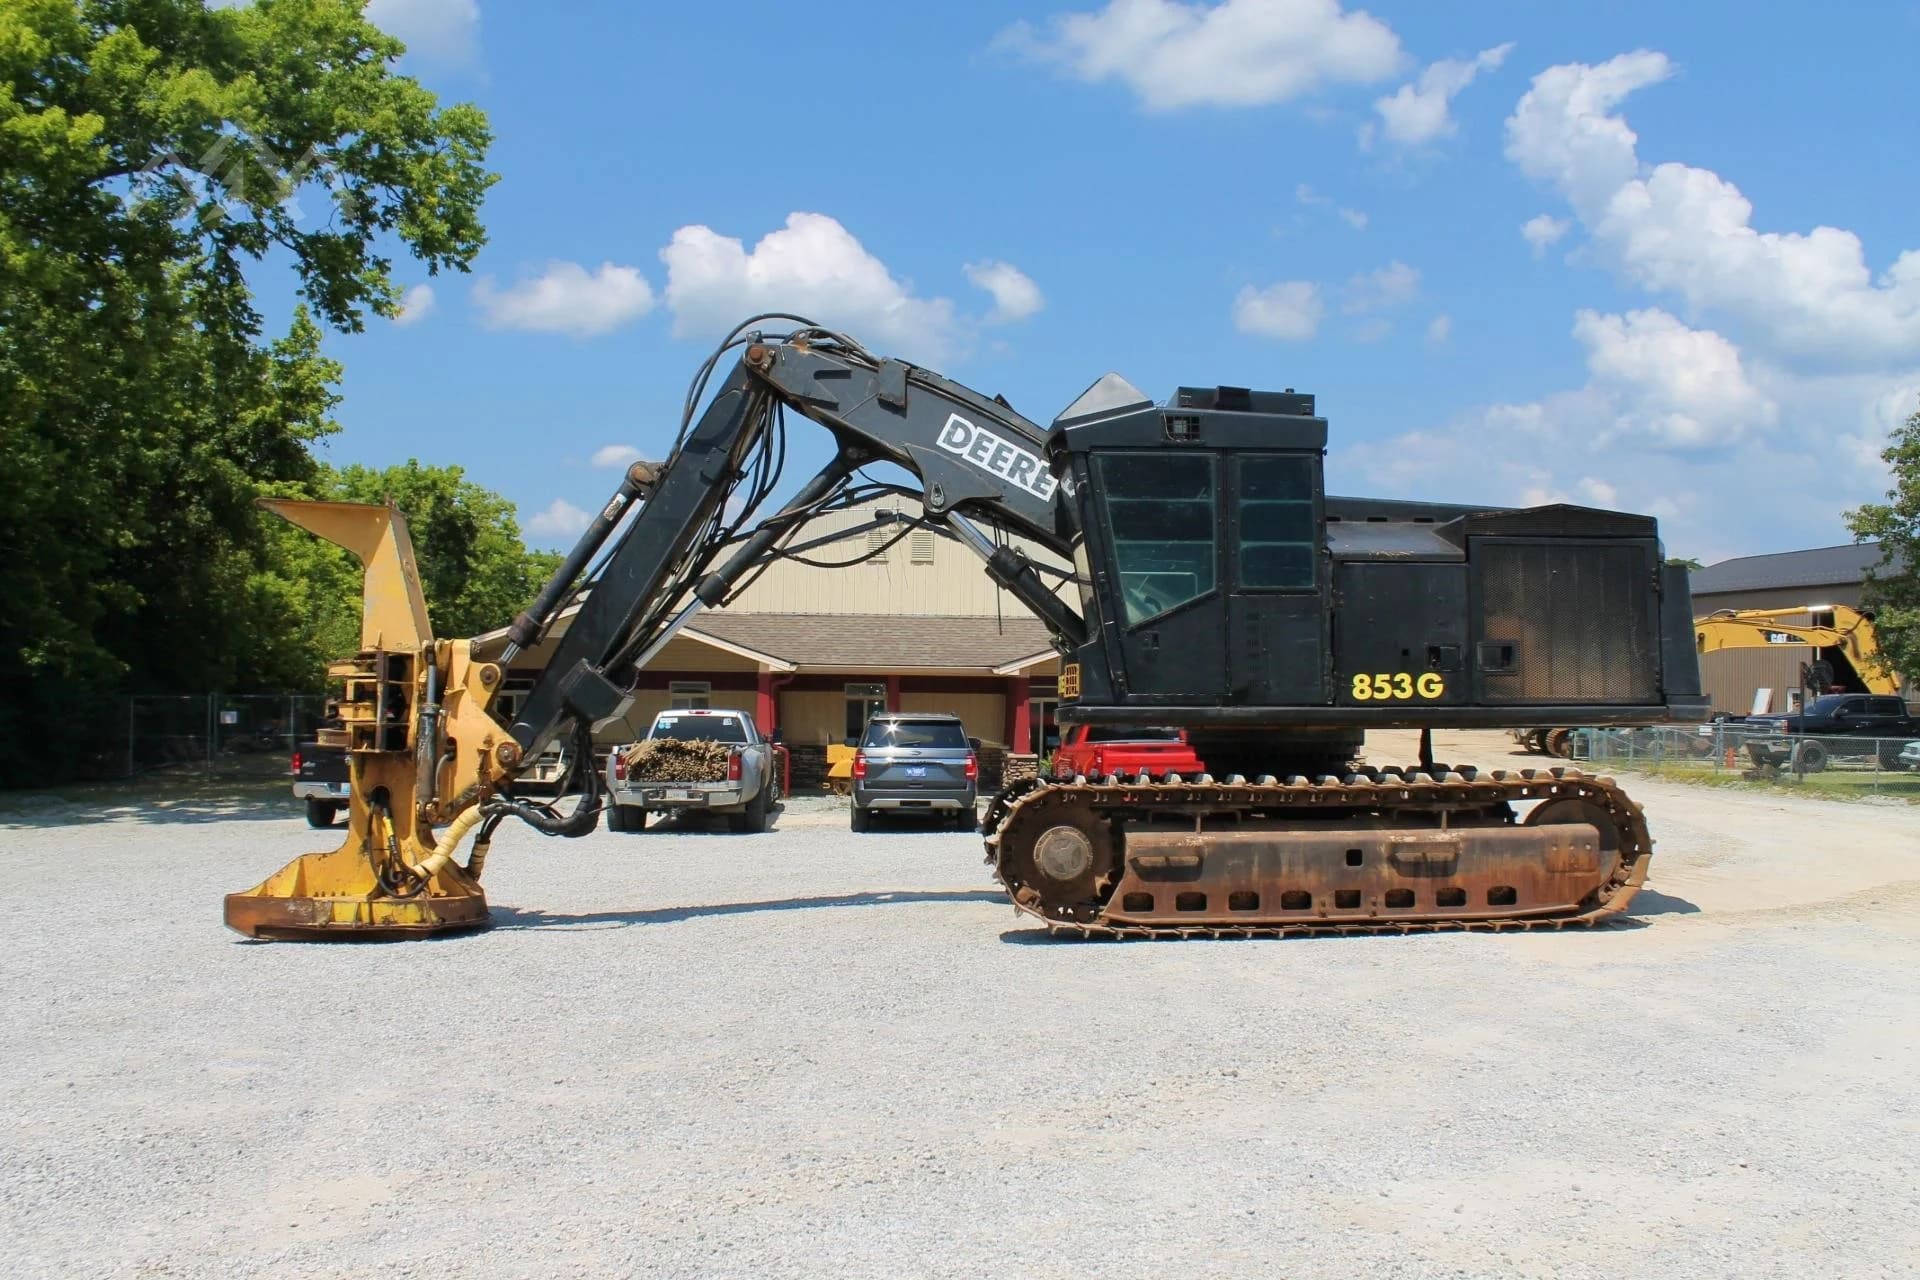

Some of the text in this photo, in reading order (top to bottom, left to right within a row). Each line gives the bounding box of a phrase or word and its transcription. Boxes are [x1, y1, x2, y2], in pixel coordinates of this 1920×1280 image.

[938, 415, 1057, 499] DEERE
[1770, 633, 1788, 643] CAT
[1351, 672, 1445, 700] 853G
